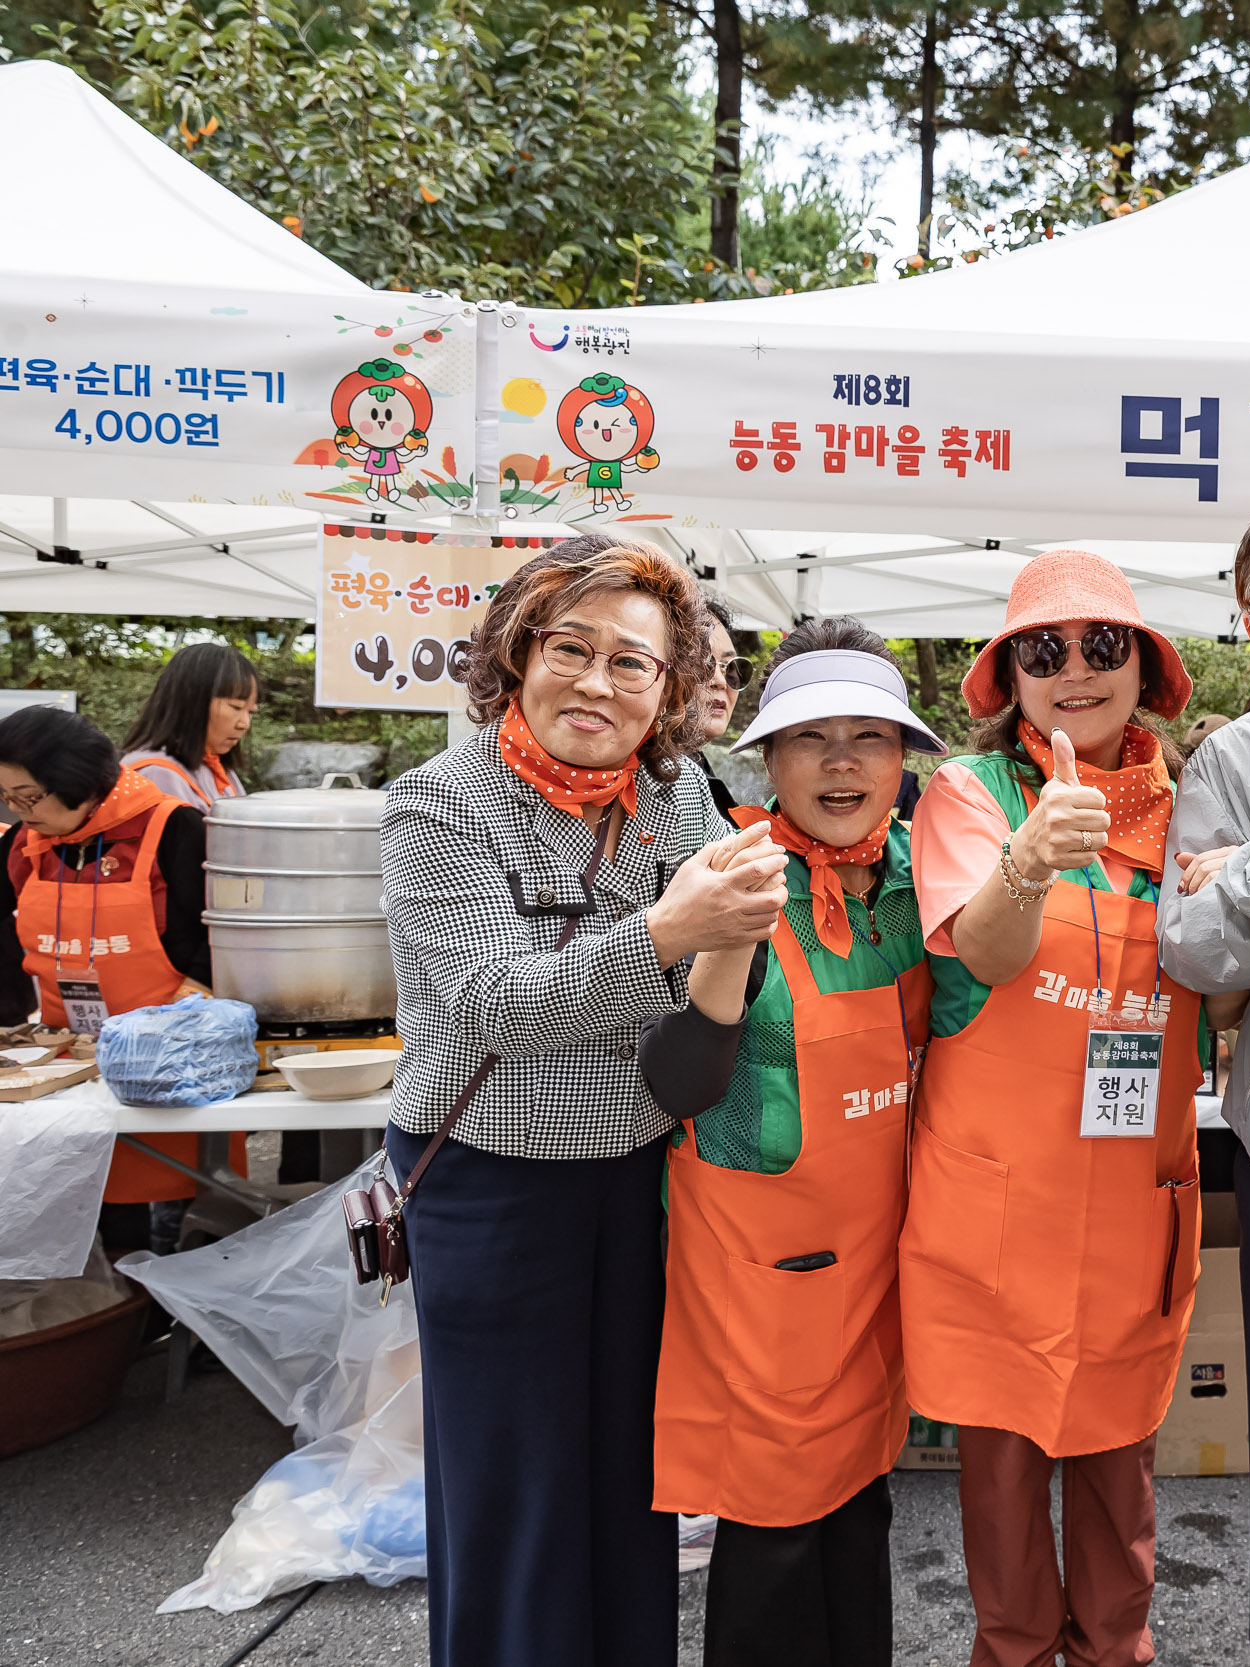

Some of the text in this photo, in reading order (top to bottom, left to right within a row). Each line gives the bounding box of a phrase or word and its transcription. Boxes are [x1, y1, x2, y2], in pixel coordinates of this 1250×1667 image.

[575, 335, 630, 356] 행복광진
[832, 374, 910, 408] 제8회
[55, 408, 219, 447] 4,000원
[730, 420, 1011, 478] 능동 감마을 축제
[37, 934, 131, 956] 감마을 능동
[1033, 969, 1172, 1027] 감마을 능동
[1092, 1050, 1158, 1061] 능동감마을축제
[1113, 1041, 1139, 1051] 제8회
[1098, 1076, 1149, 1100] 행사
[1096, 1103, 1146, 1126] 지원
